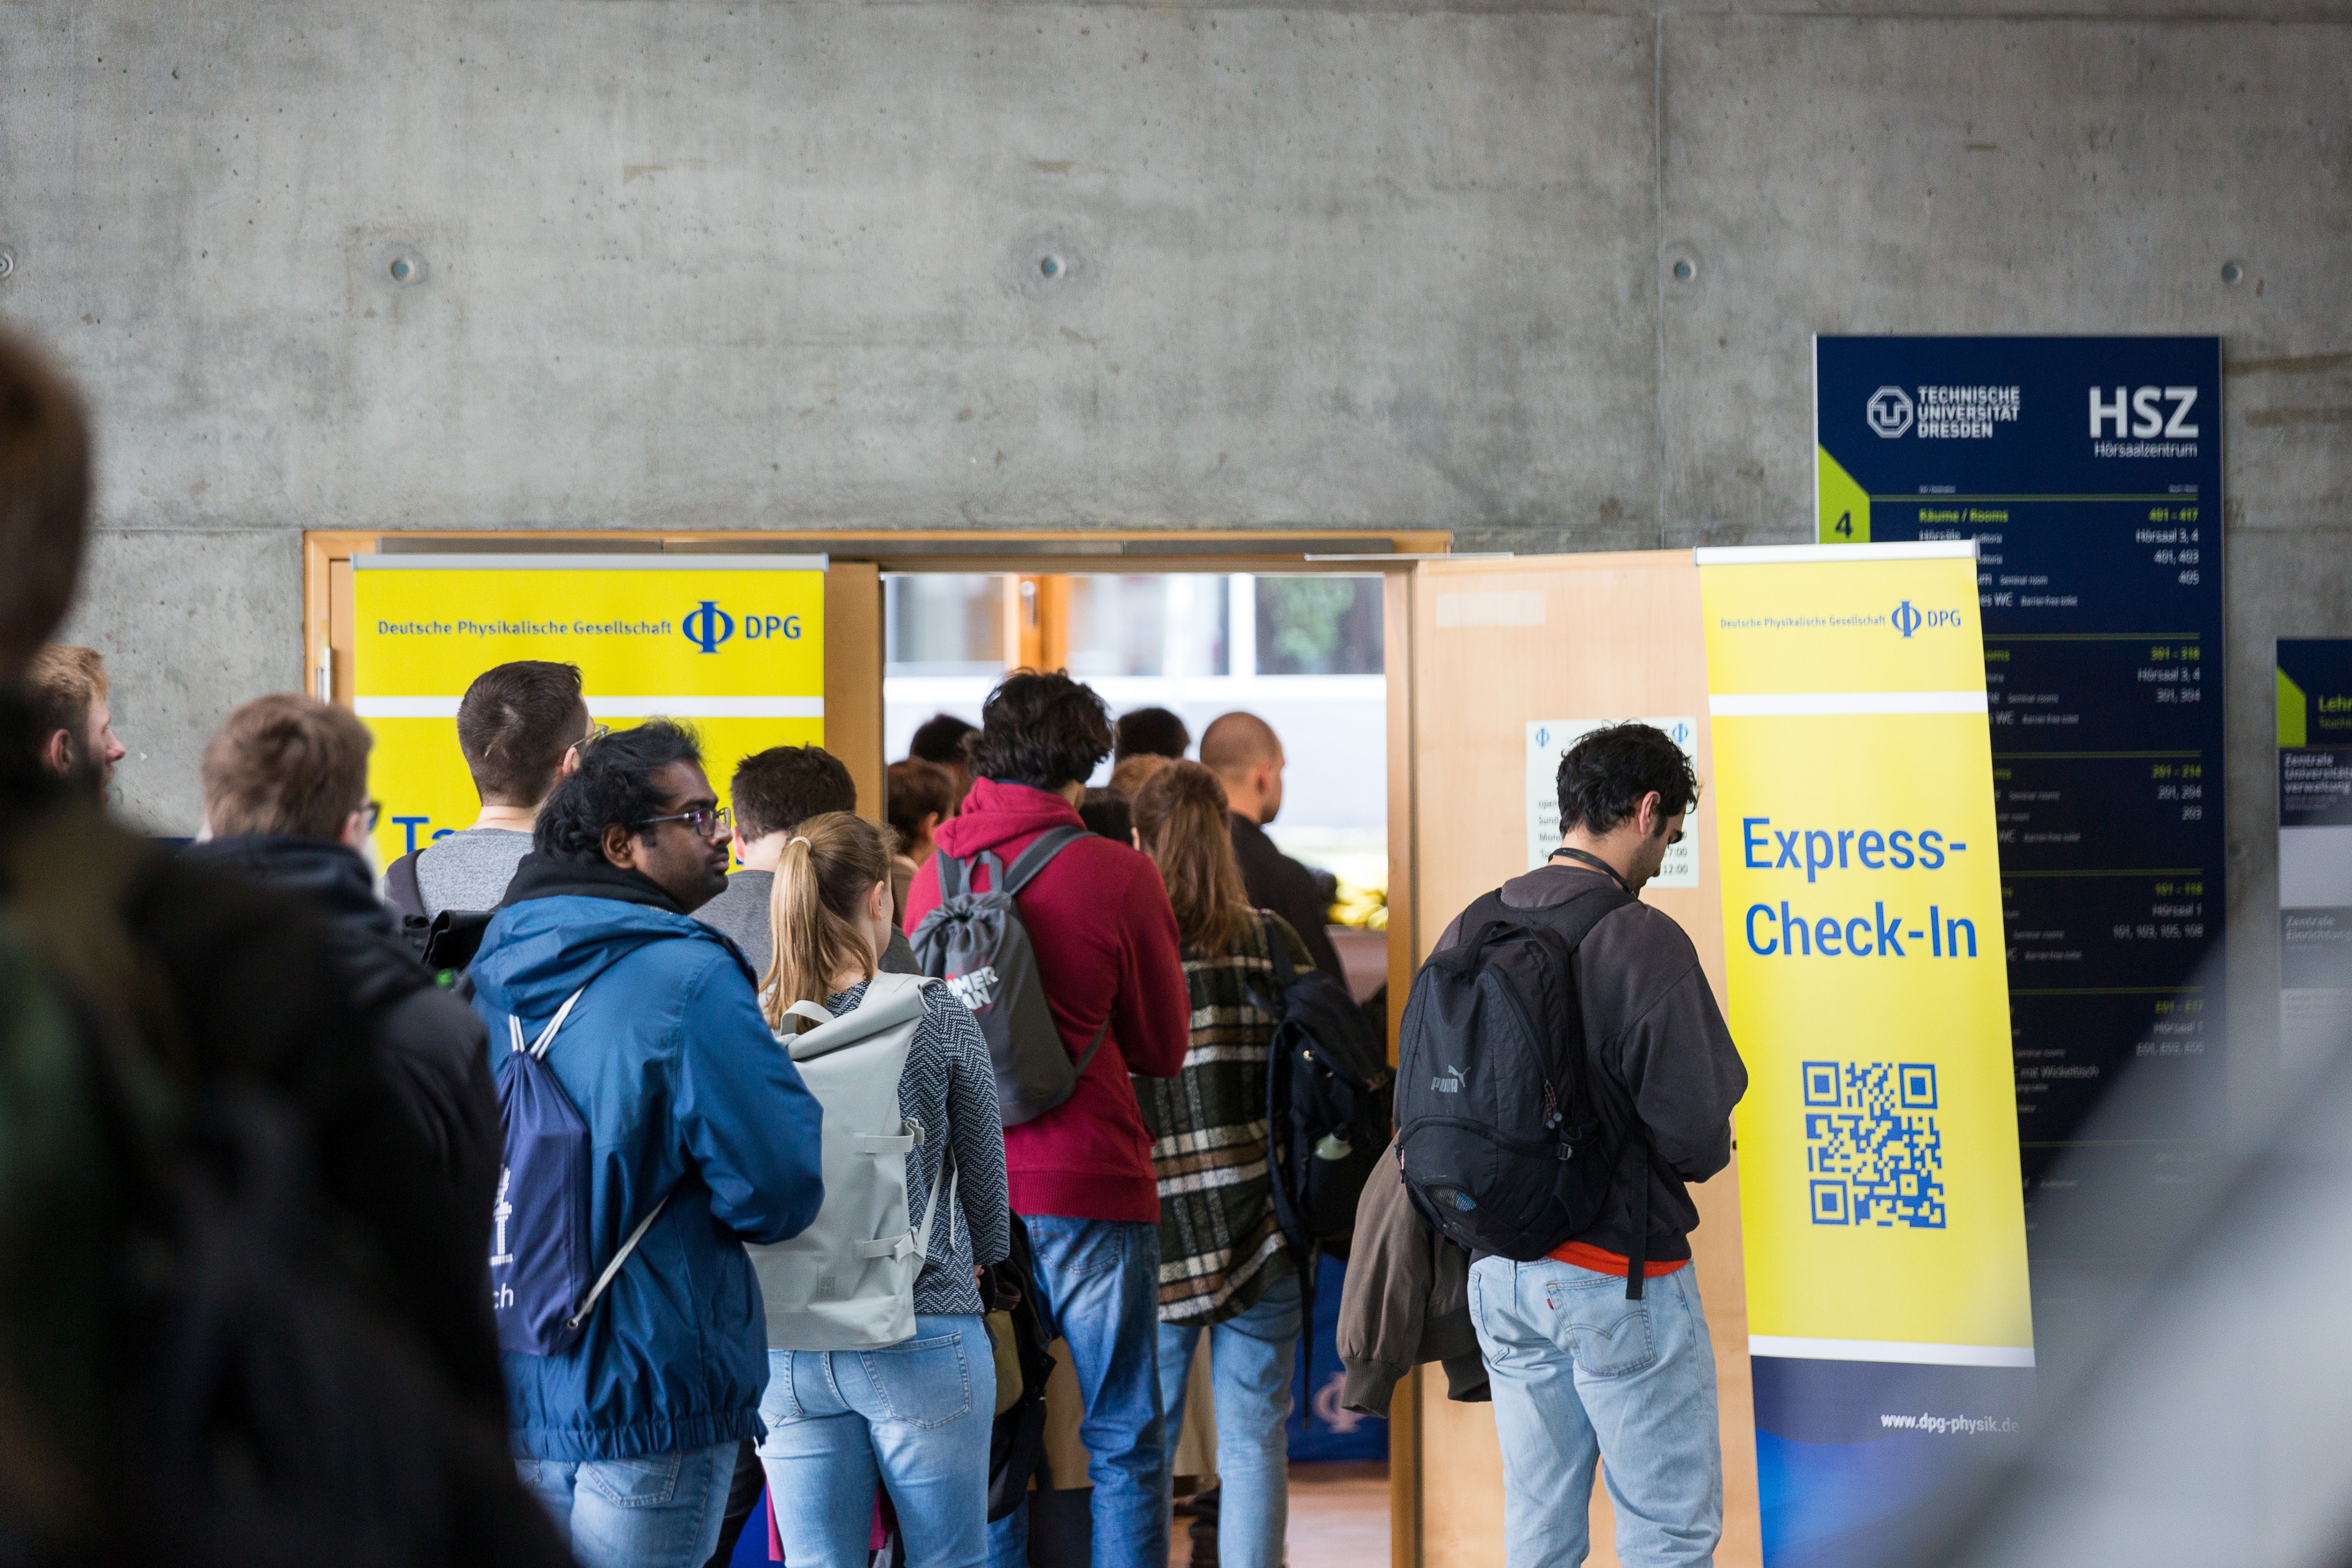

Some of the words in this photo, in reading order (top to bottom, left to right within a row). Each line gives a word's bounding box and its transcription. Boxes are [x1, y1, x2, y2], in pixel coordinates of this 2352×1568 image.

[1917, 386, 2020, 404] TECHNISCHE
[1917, 403, 2019, 421] UNIVERSITÄT
[2090, 385, 2199, 439] HSZ
[1917, 420, 1993, 438] DRESDEN
[2094, 441, 2197, 457] Hörsaalzentrum
[1919, 508, 1960, 523] Räume
[1970, 509, 2008, 523] Rooms
[2149, 508, 2168, 522] 401
[1835, 510, 1853, 538] 4
[2136, 528, 2177, 543] Hörsaal
[2190, 528, 2199, 543] 4
[2154, 549, 2176, 565] 401,
[2178, 548, 2199, 564] 403
[378, 621, 452, 635] Deutsche
[457, 620, 568, 637] Physikalische
[573, 620, 672, 635] Gesellschaft
[745, 615, 801, 640] DPG
[1721, 618, 1761, 629] Deutsche
[1764, 616, 1826, 629] Physikalische
[1829, 614, 1886, 626] Gesellschaft
[1927, 610, 1961, 627] DPG
[2137, 667, 2179, 682] Hörsaal
[2192, 667, 2200, 681] 4
[2285, 753, 2334, 767] Zentrale
[1743, 817, 1967, 882] Express-
[1664, 863, 1688, 875] 12:00
[2152, 903, 2193, 917] Hörsaal
[1746, 900, 1977, 958] Check-In
[1431, 1077, 1458, 1093] PUMA
[1881, 1412, 2019, 1435] www.dpg-physik.de
